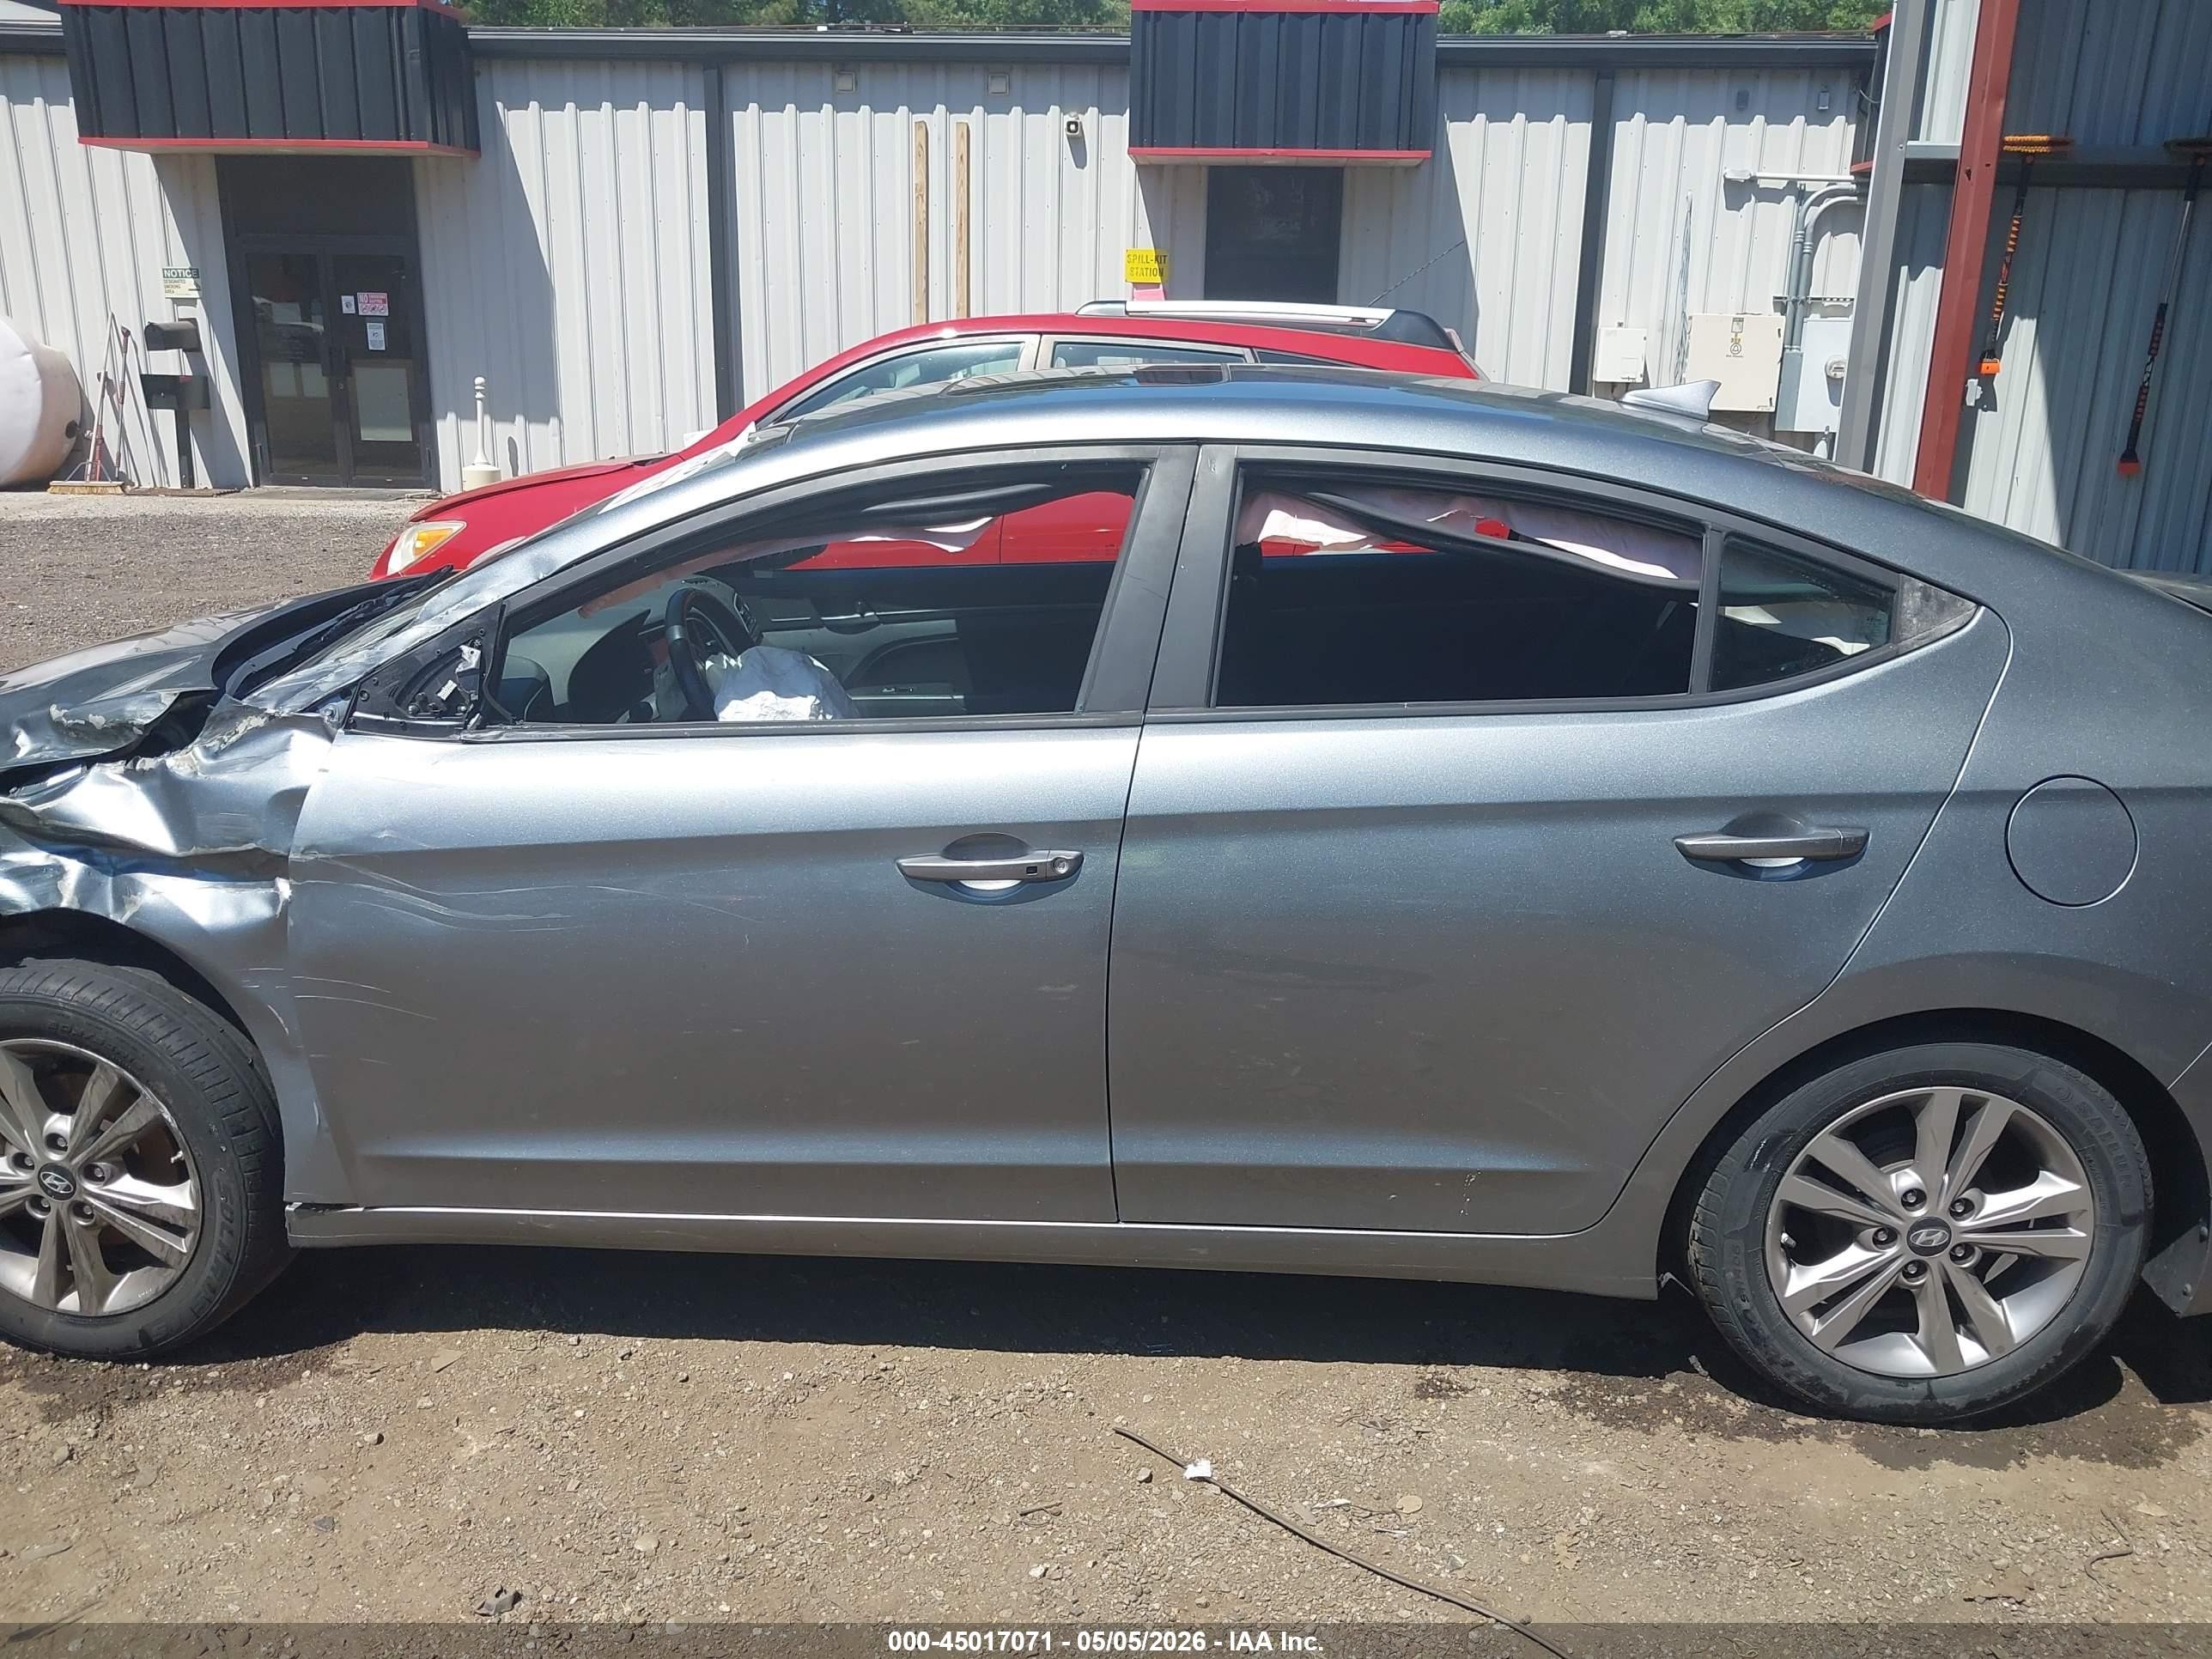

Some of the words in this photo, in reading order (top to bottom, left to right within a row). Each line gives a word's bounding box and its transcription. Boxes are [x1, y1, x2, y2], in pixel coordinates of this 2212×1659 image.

[1127, 253, 1168, 264] SPILL-KIT
[163, 269, 198, 277] NOTICE
[1129, 267, 1164, 276] STATION
